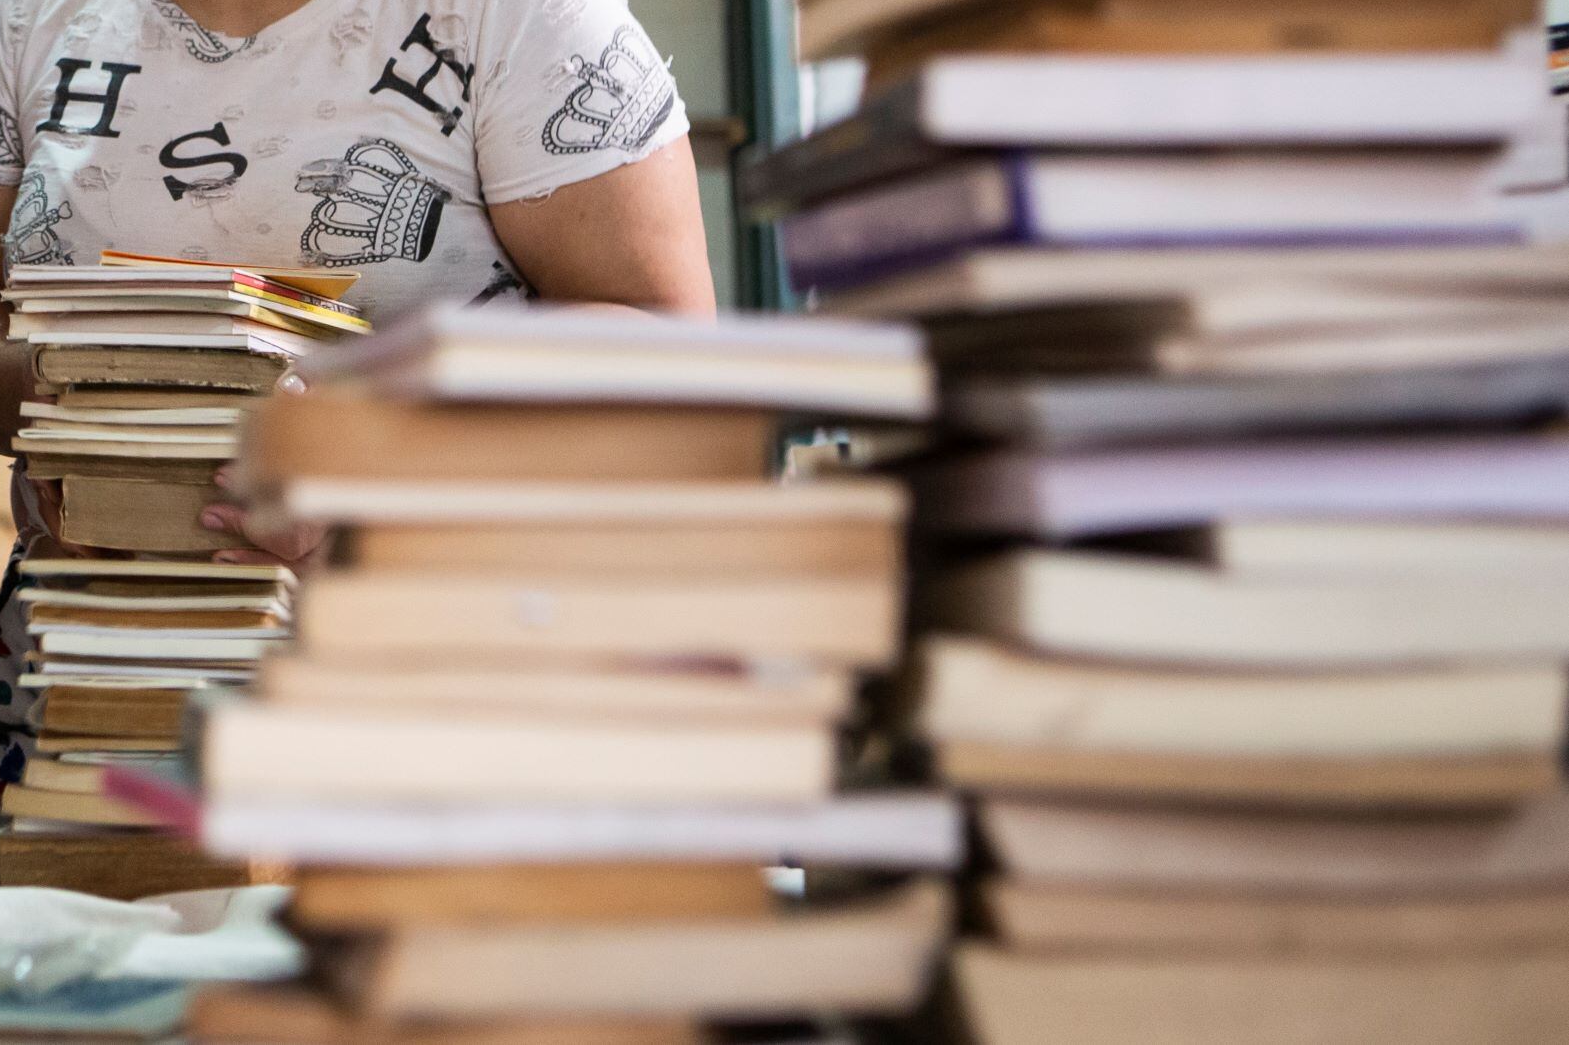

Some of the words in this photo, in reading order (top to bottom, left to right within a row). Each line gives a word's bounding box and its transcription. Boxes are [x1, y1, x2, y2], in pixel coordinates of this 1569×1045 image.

[36, 57, 142, 138] H
[369, 12, 475, 138] H
[159, 121, 248, 202] S
